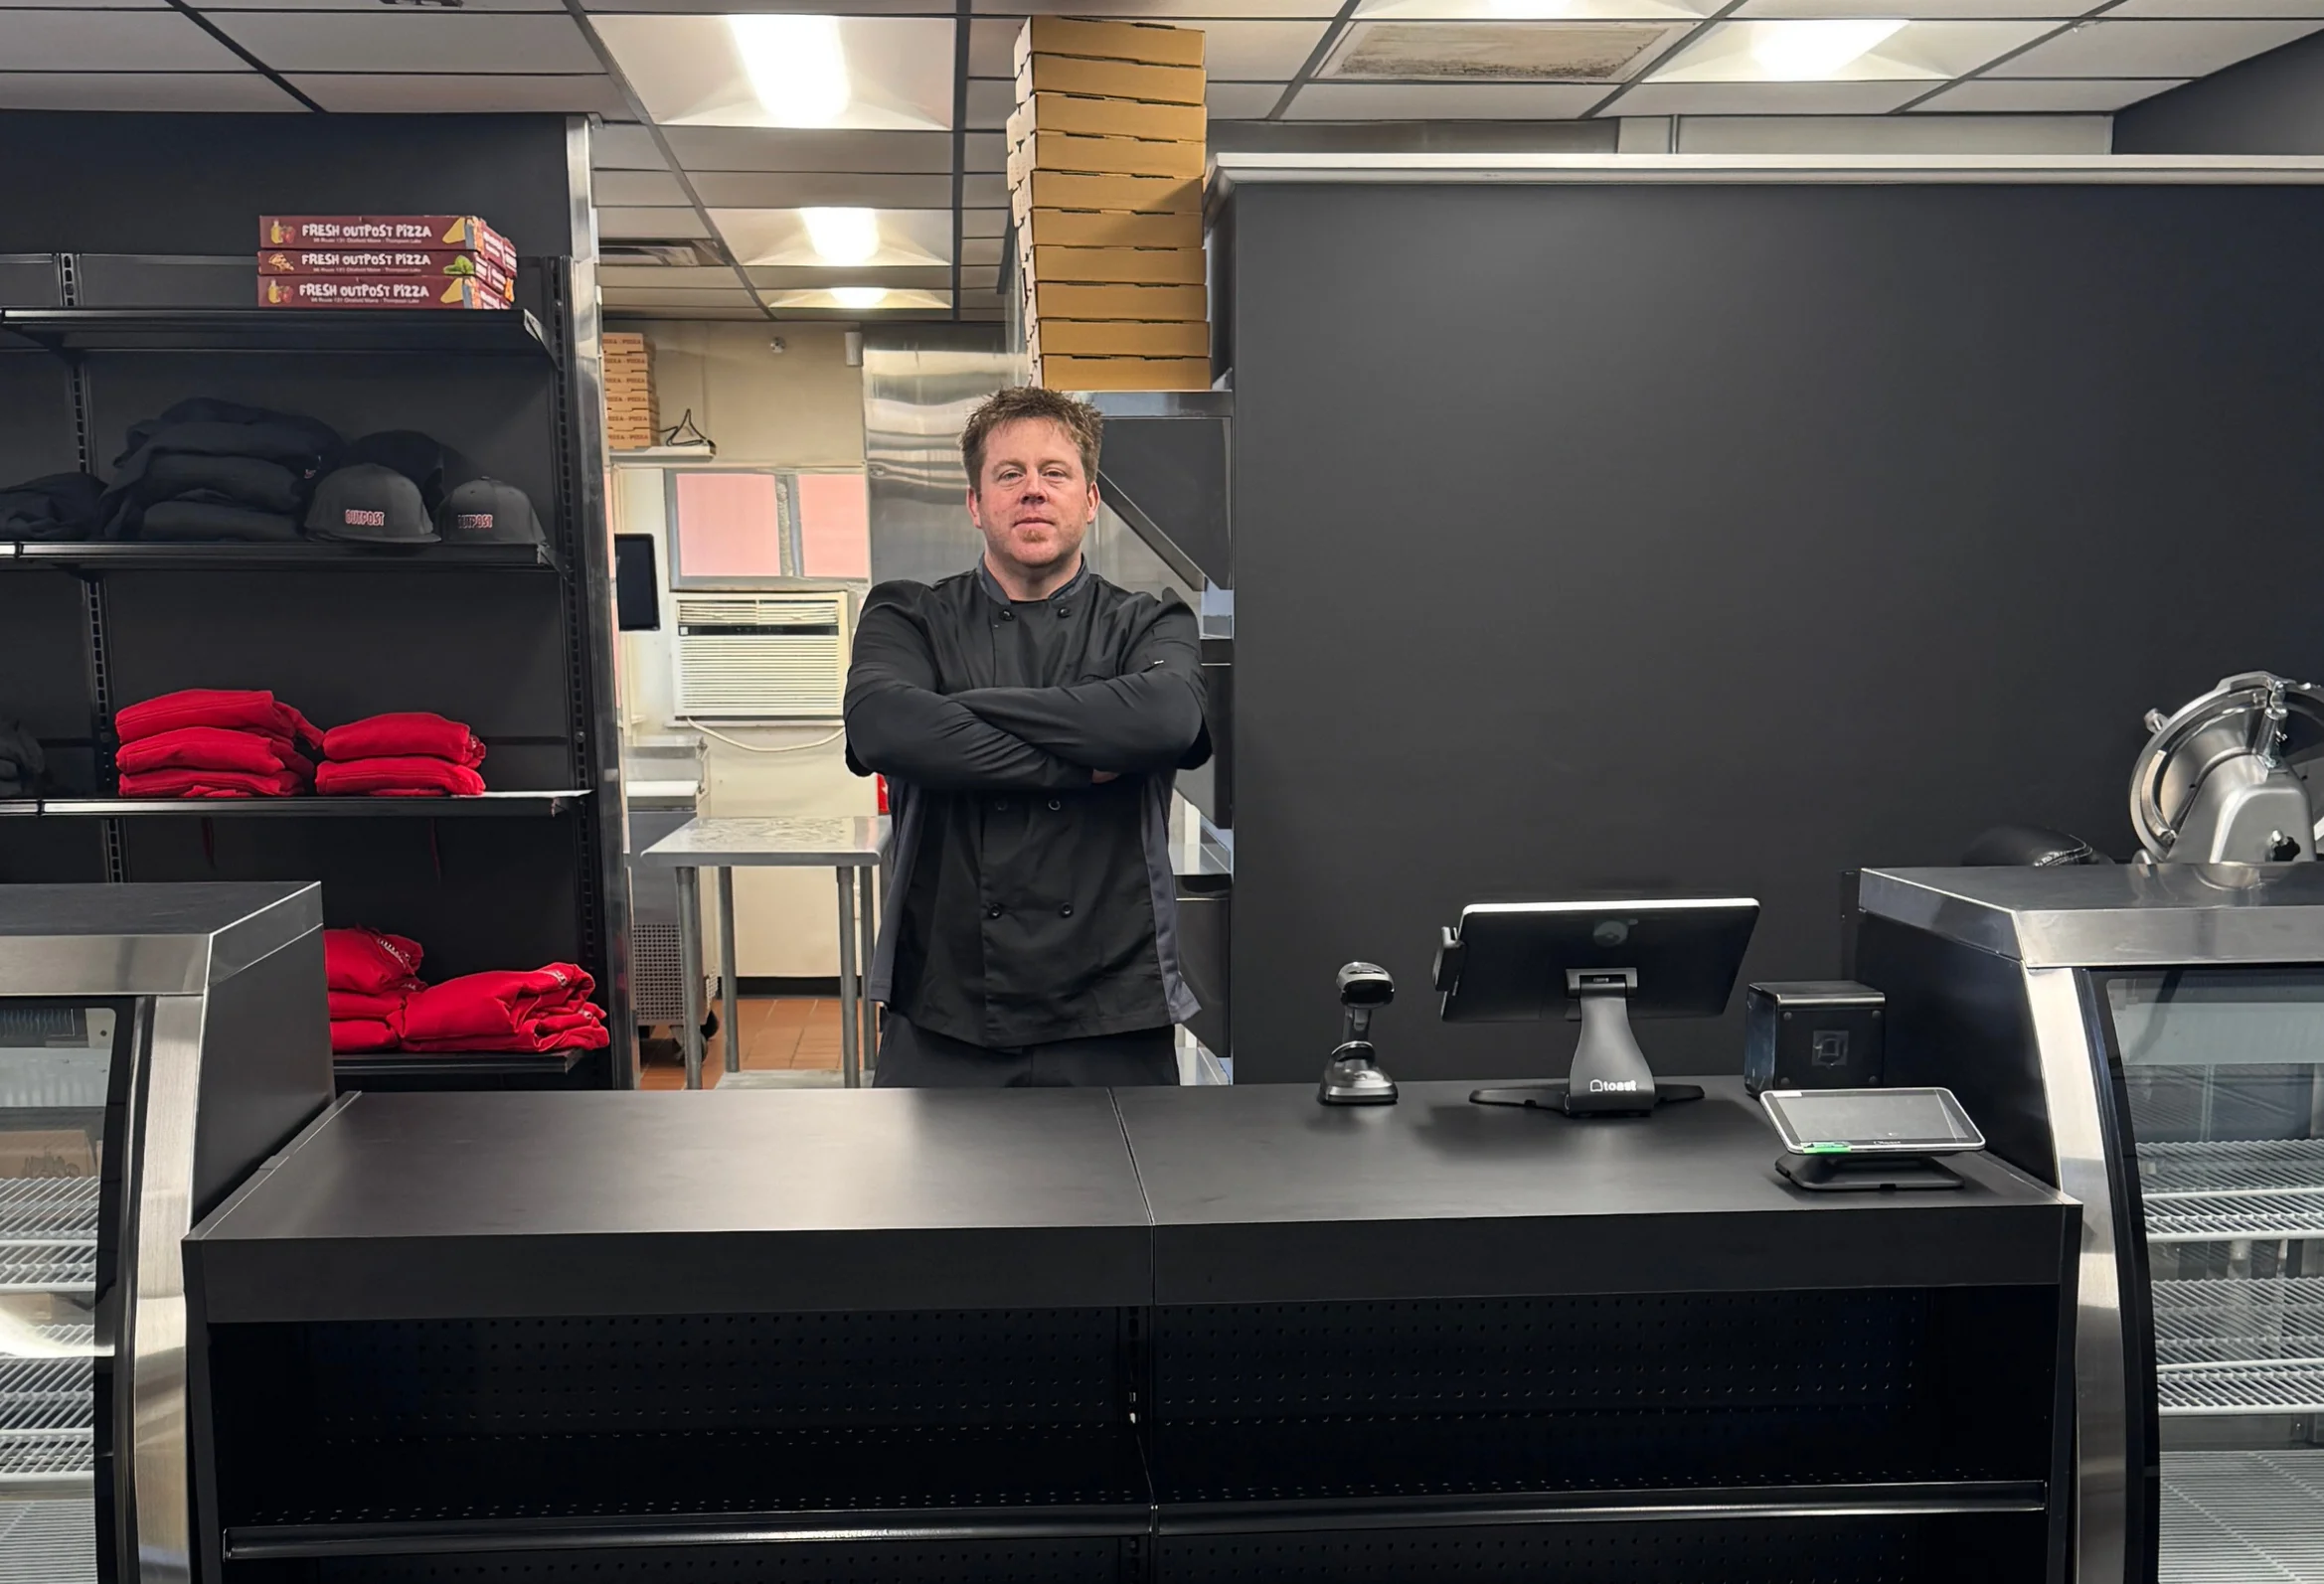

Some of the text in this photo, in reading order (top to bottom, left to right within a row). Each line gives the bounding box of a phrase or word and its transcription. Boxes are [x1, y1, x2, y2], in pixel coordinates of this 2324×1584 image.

[302, 224, 340, 237] FRESH
[301, 253, 340, 265] FRESH
[299, 283, 337, 296] FRESH
[345, 509, 385, 526] OUTPOST
[1603, 1079, 1637, 1091] toast
